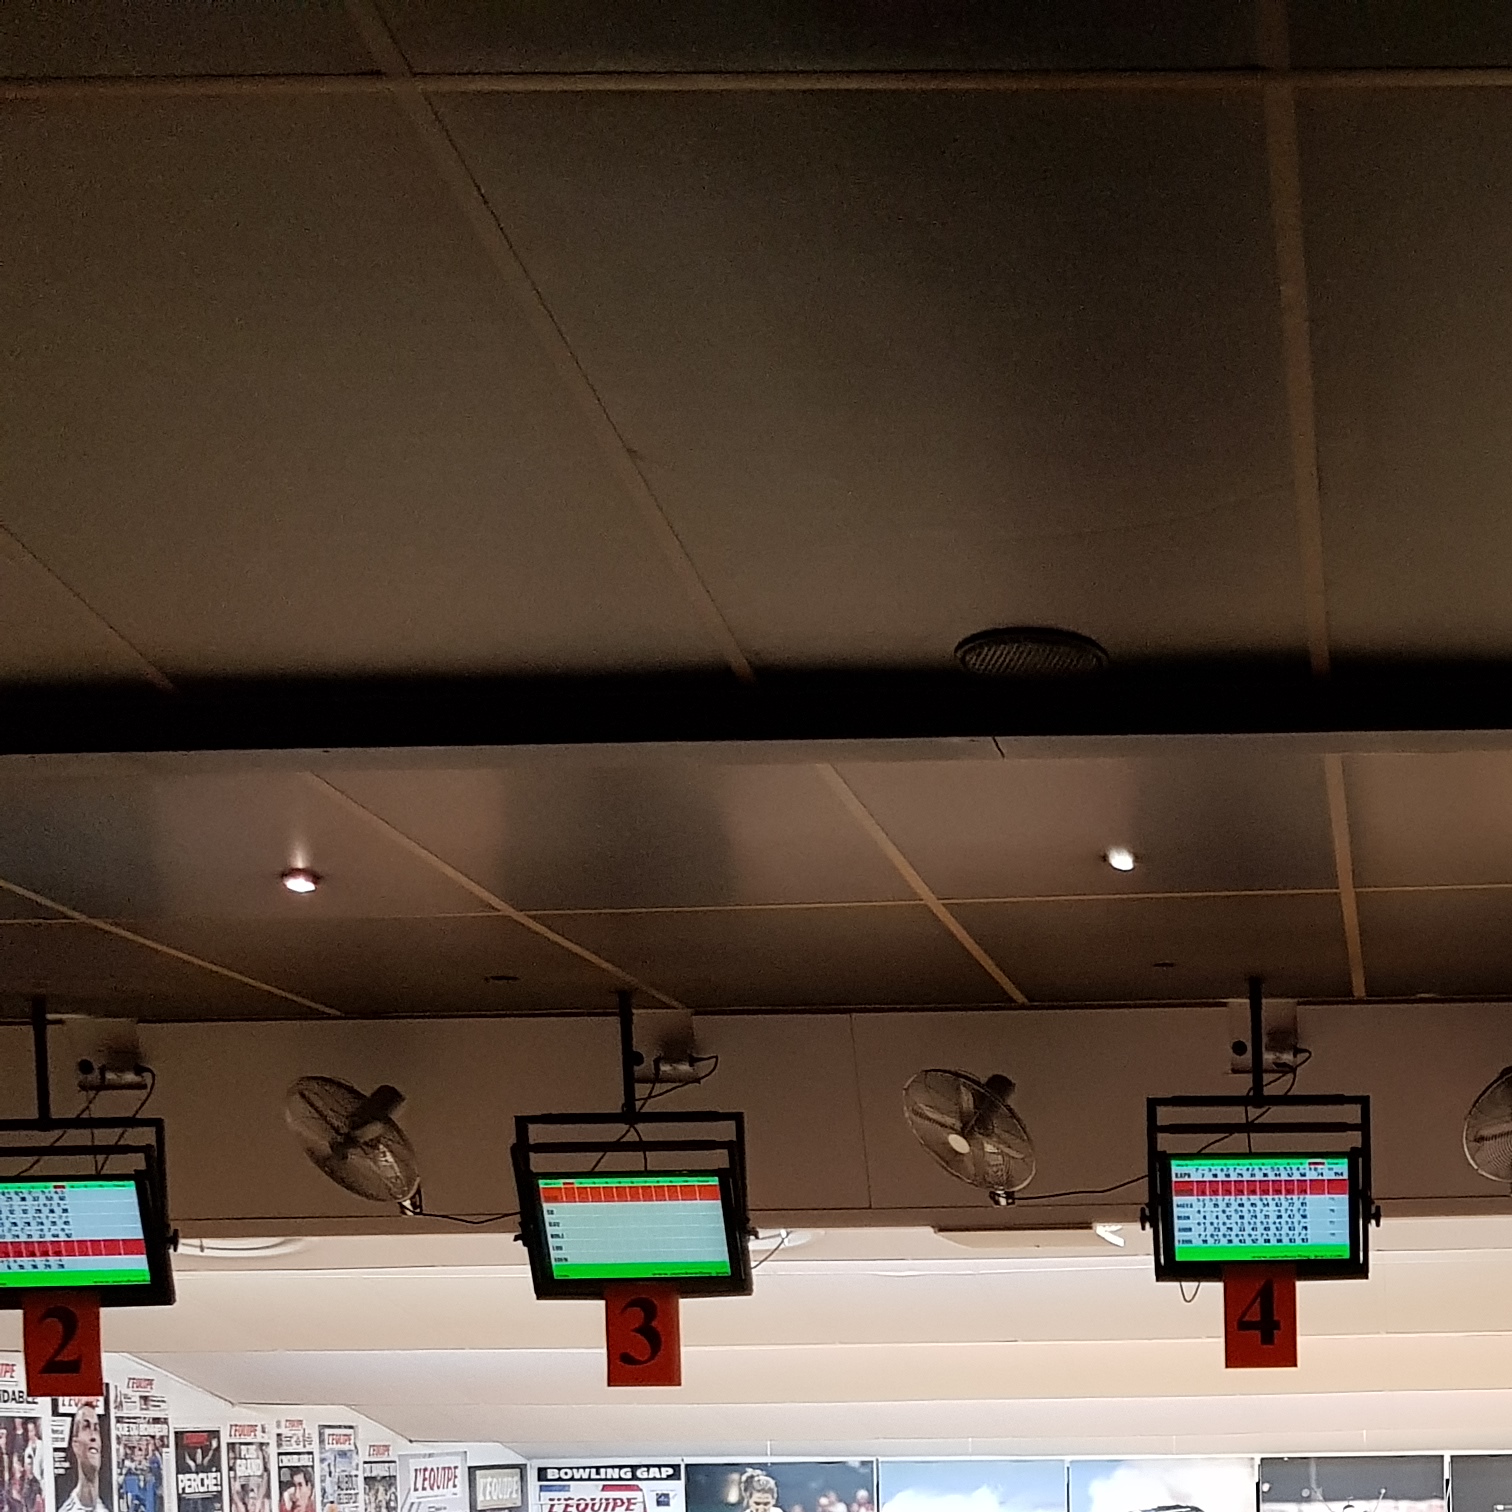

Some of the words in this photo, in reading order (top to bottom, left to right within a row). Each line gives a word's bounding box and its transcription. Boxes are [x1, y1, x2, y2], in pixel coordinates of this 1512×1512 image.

[38, 1305, 83, 1374] 2
[619, 1296, 662, 1366] 3
[1236, 1278, 1281, 1346] 4
[546, 1468, 632, 1480] BOWLING
[636, 1467, 674, 1479] GAP
